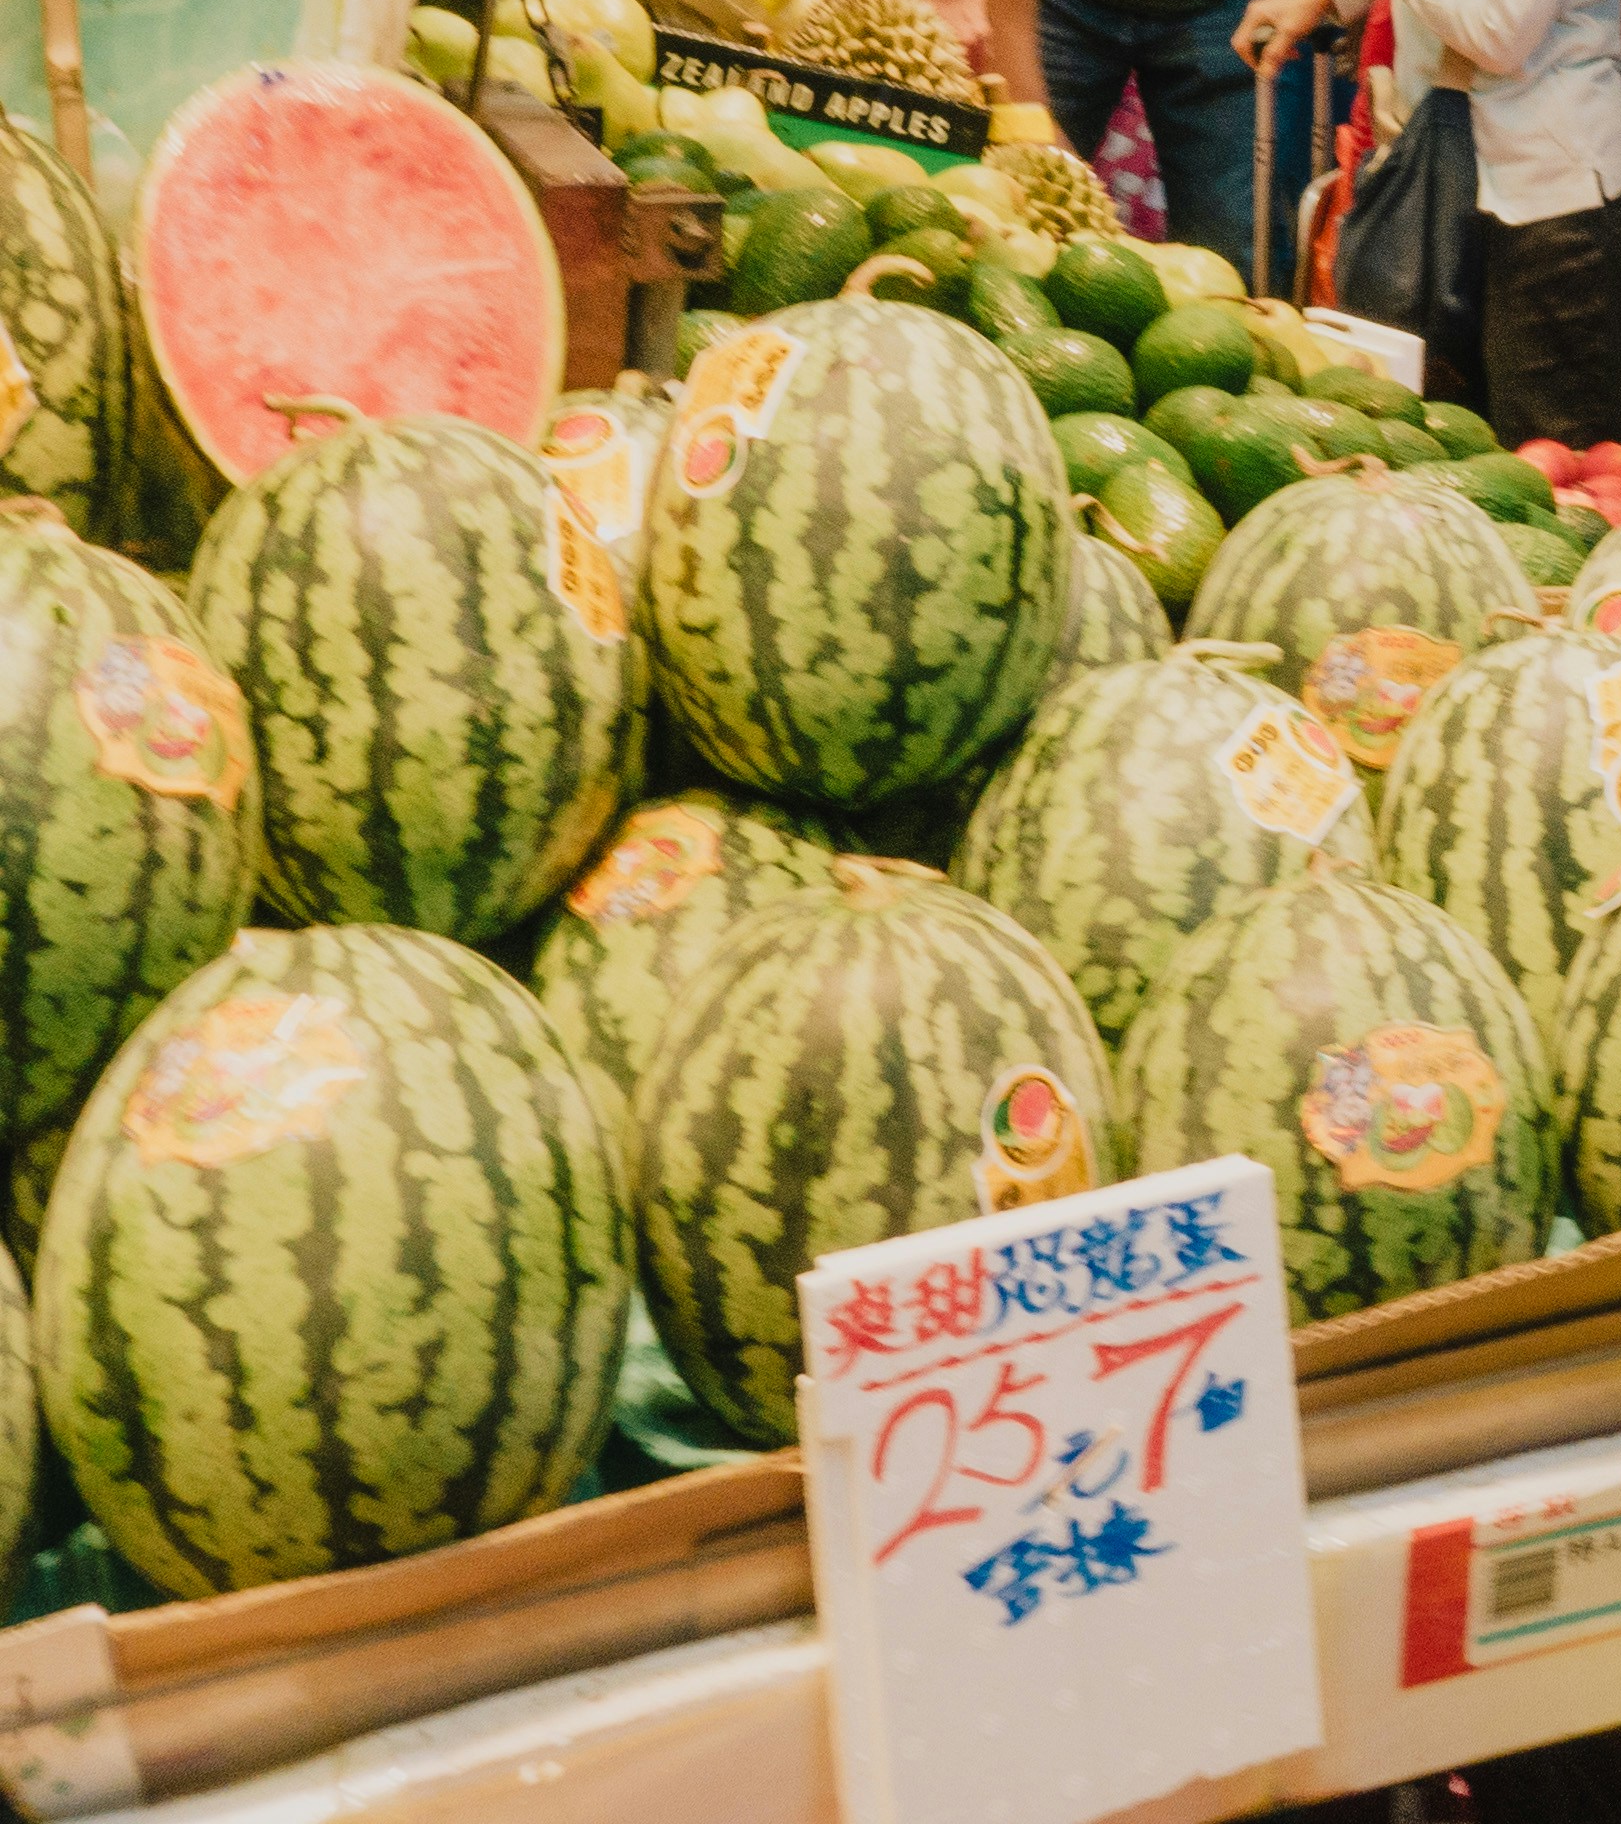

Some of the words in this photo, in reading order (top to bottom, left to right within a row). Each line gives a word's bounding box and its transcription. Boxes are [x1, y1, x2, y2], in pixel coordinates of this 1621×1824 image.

[823, 92, 951, 144] APPLES
[871, 1359, 1047, 1566] 25
[1091, 1301, 1245, 1494] 7
